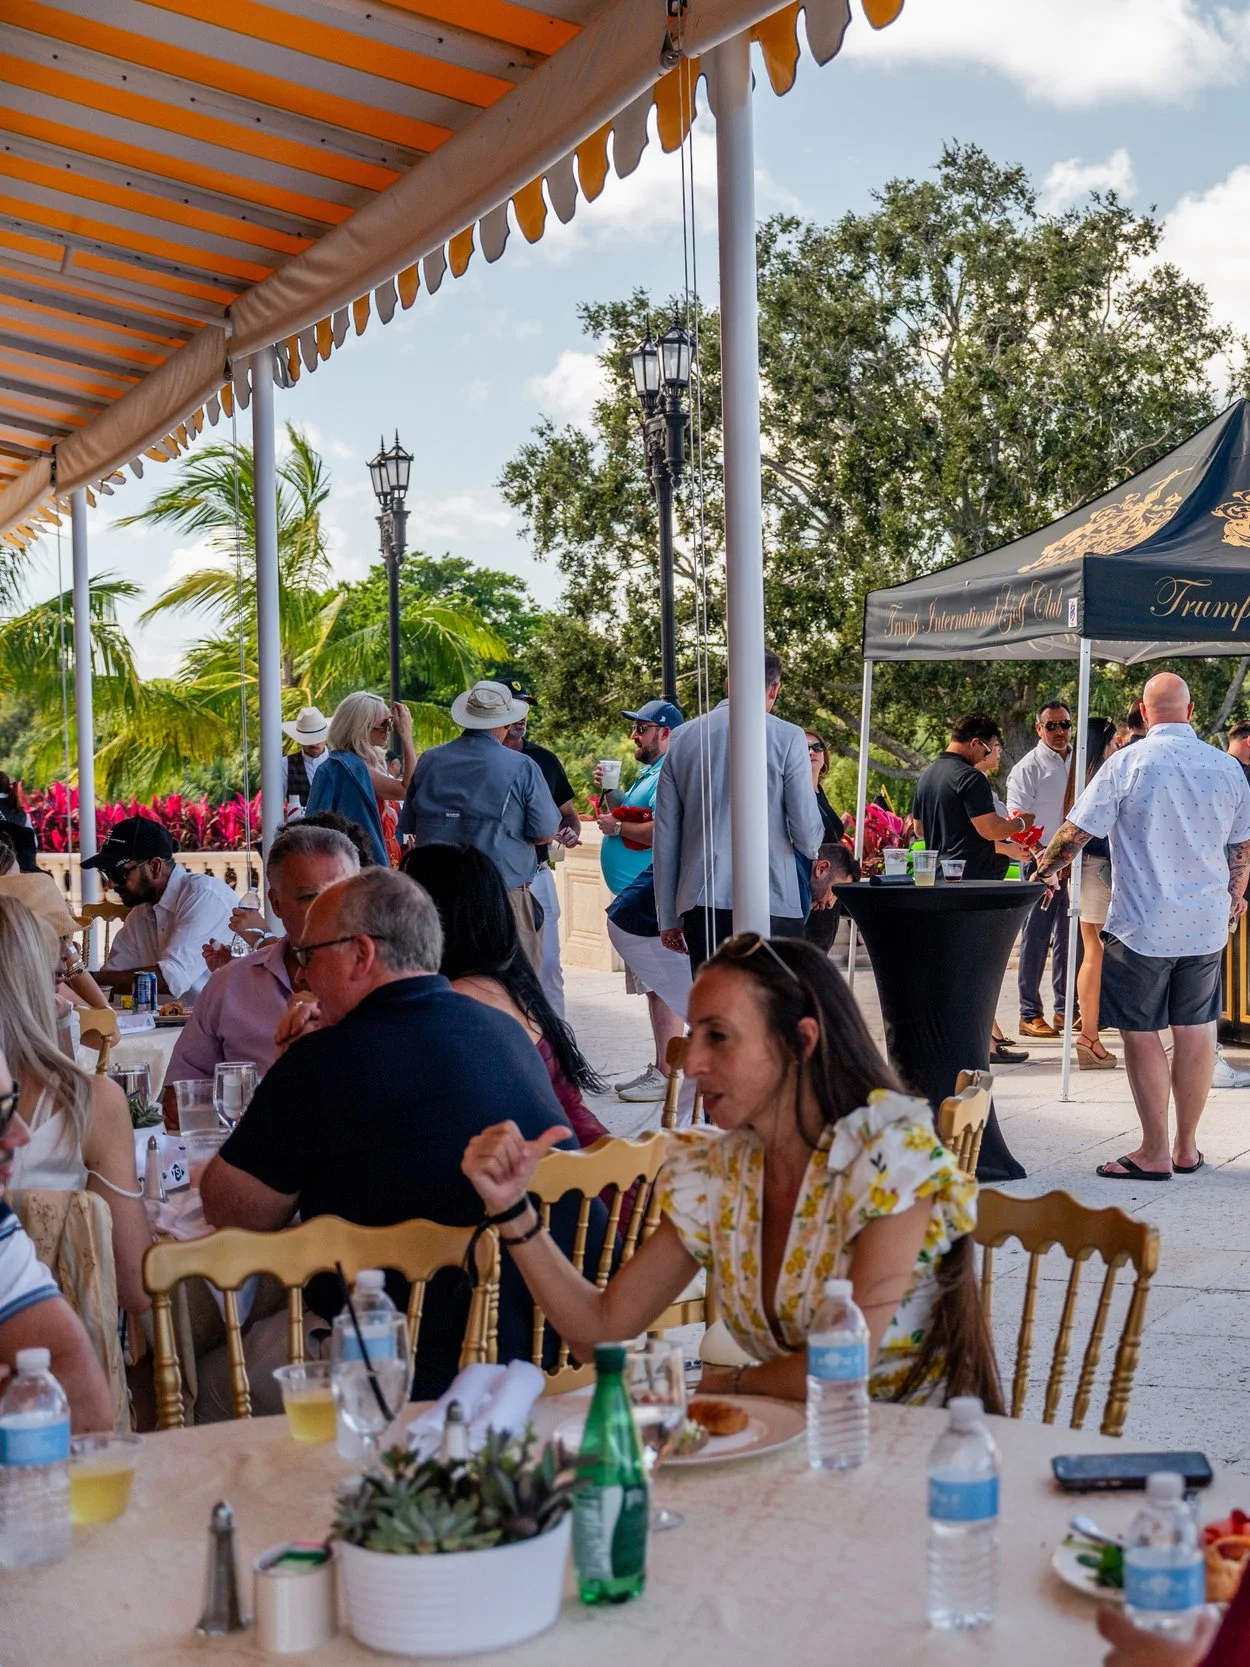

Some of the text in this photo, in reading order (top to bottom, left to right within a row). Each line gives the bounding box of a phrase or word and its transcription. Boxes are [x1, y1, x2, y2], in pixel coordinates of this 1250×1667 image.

[884, 603, 919, 647] Trump
[922, 597, 999, 635] International
[1031, 580, 1063, 622] Club
